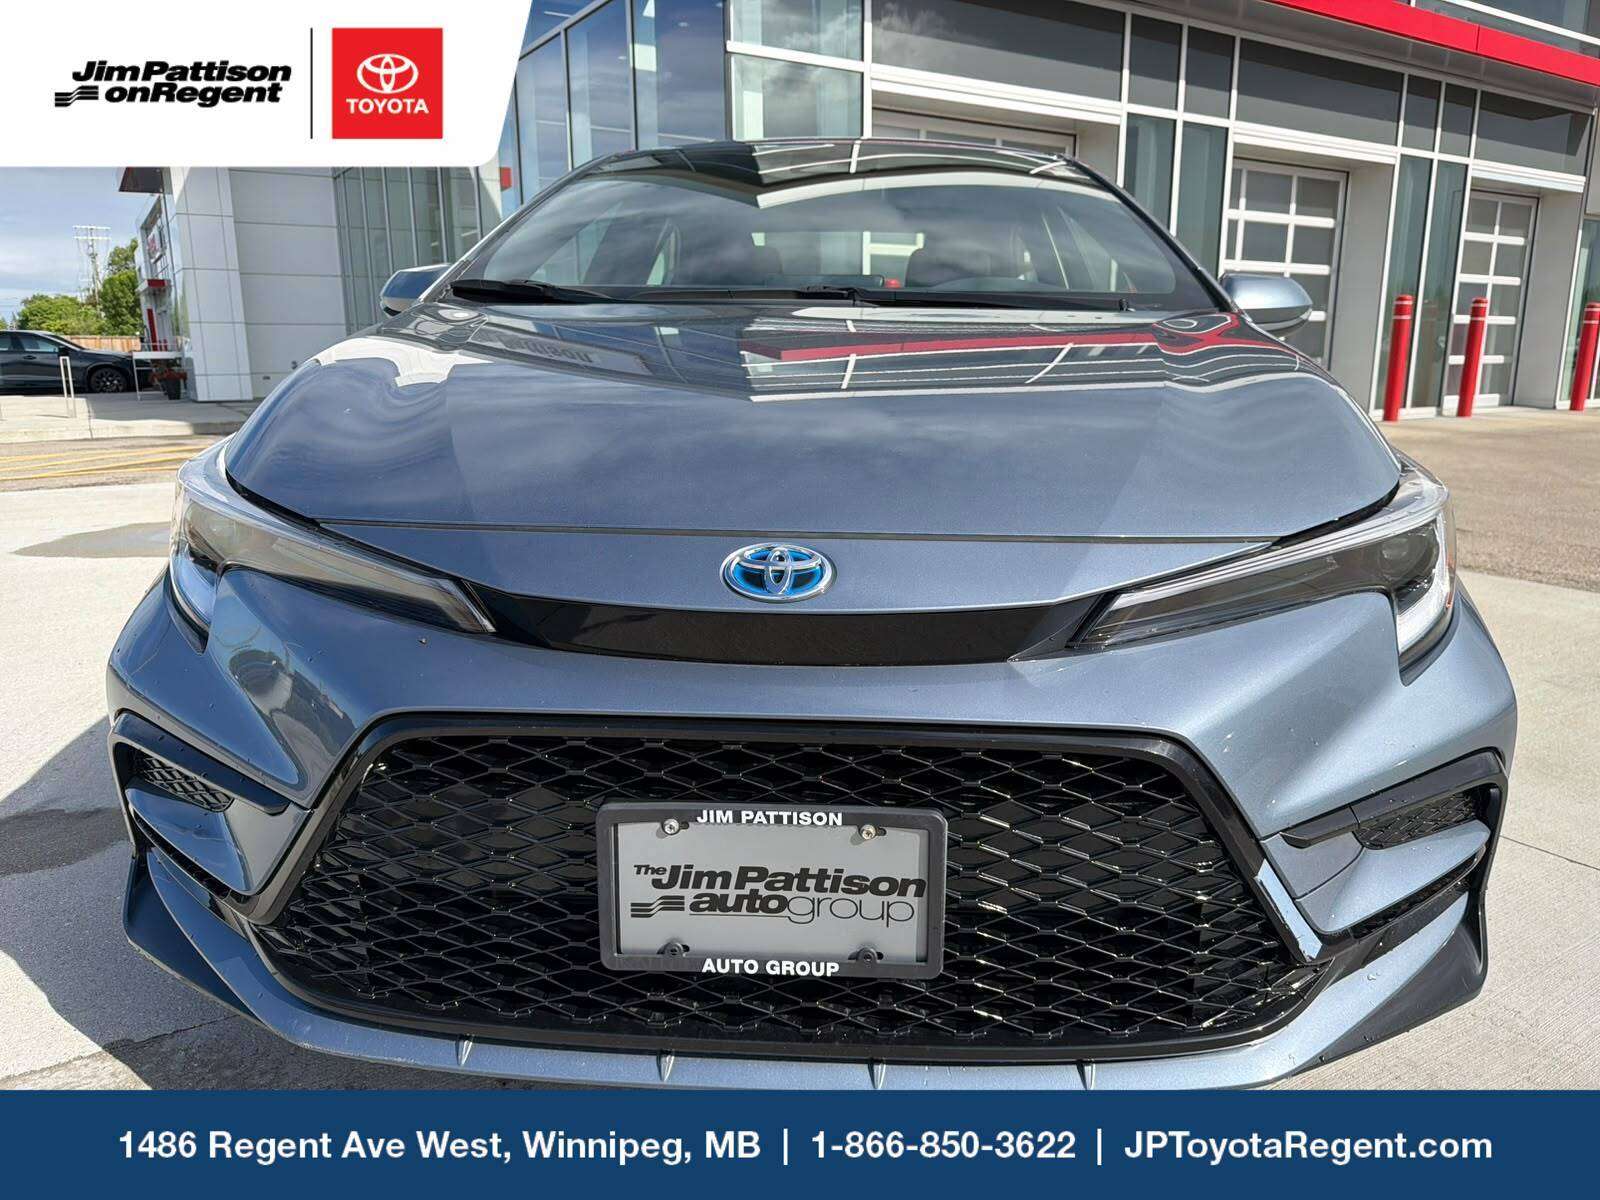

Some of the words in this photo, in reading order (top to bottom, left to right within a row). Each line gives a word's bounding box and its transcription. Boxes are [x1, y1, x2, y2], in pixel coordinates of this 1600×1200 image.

[696, 809, 734, 825] JIM
[741, 810, 844, 827] PATTISON
[633, 864, 667, 876] The
[701, 958, 760, 976] AUTO
[765, 959, 841, 978] GROUP
